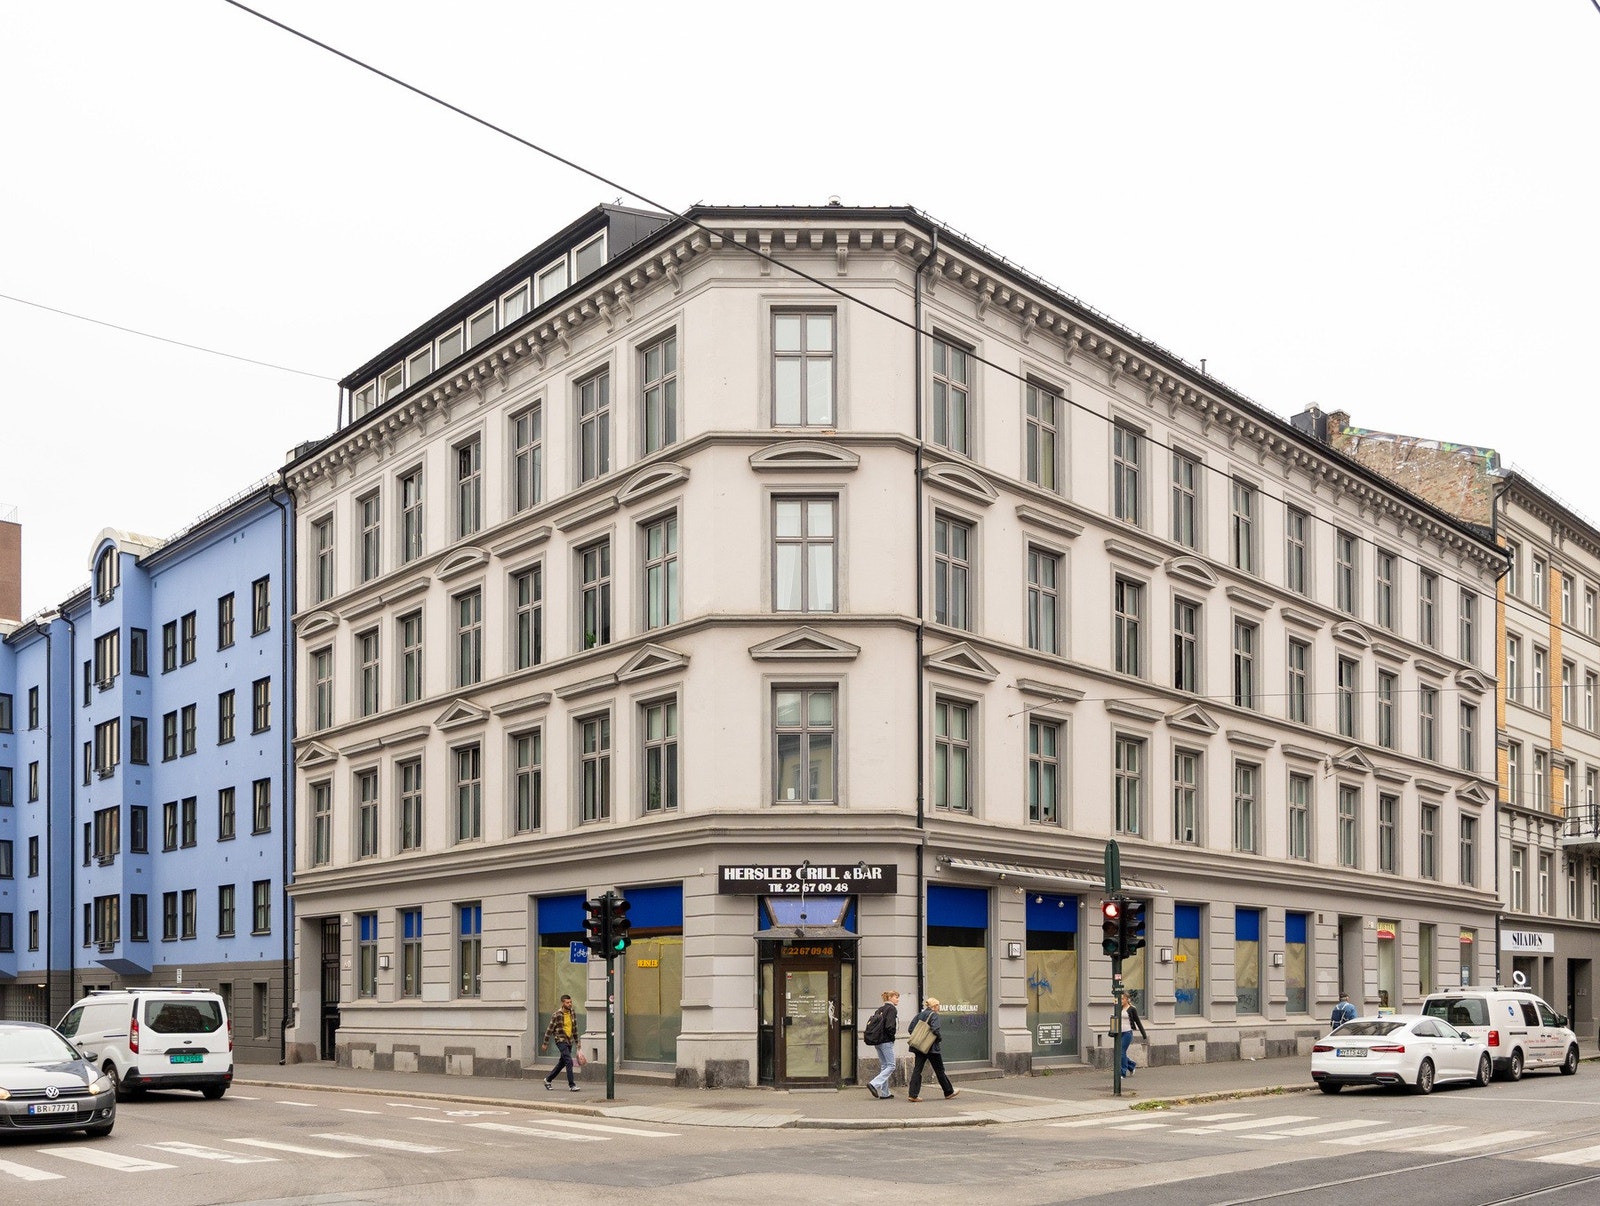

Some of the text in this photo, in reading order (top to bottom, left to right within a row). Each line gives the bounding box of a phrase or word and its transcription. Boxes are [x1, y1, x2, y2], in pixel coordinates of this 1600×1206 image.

[724, 867, 792, 880] HERSLEB
[785, 883, 800, 893] 22
[802, 883, 816, 894] 67
[817, 883, 832, 893] 09
[834, 883, 848, 893] 48
[1512, 932, 1543, 947] SHADES
[788, 947, 833, 956] 22 67 09 48
[51, 1103, 76, 1112] 77774
